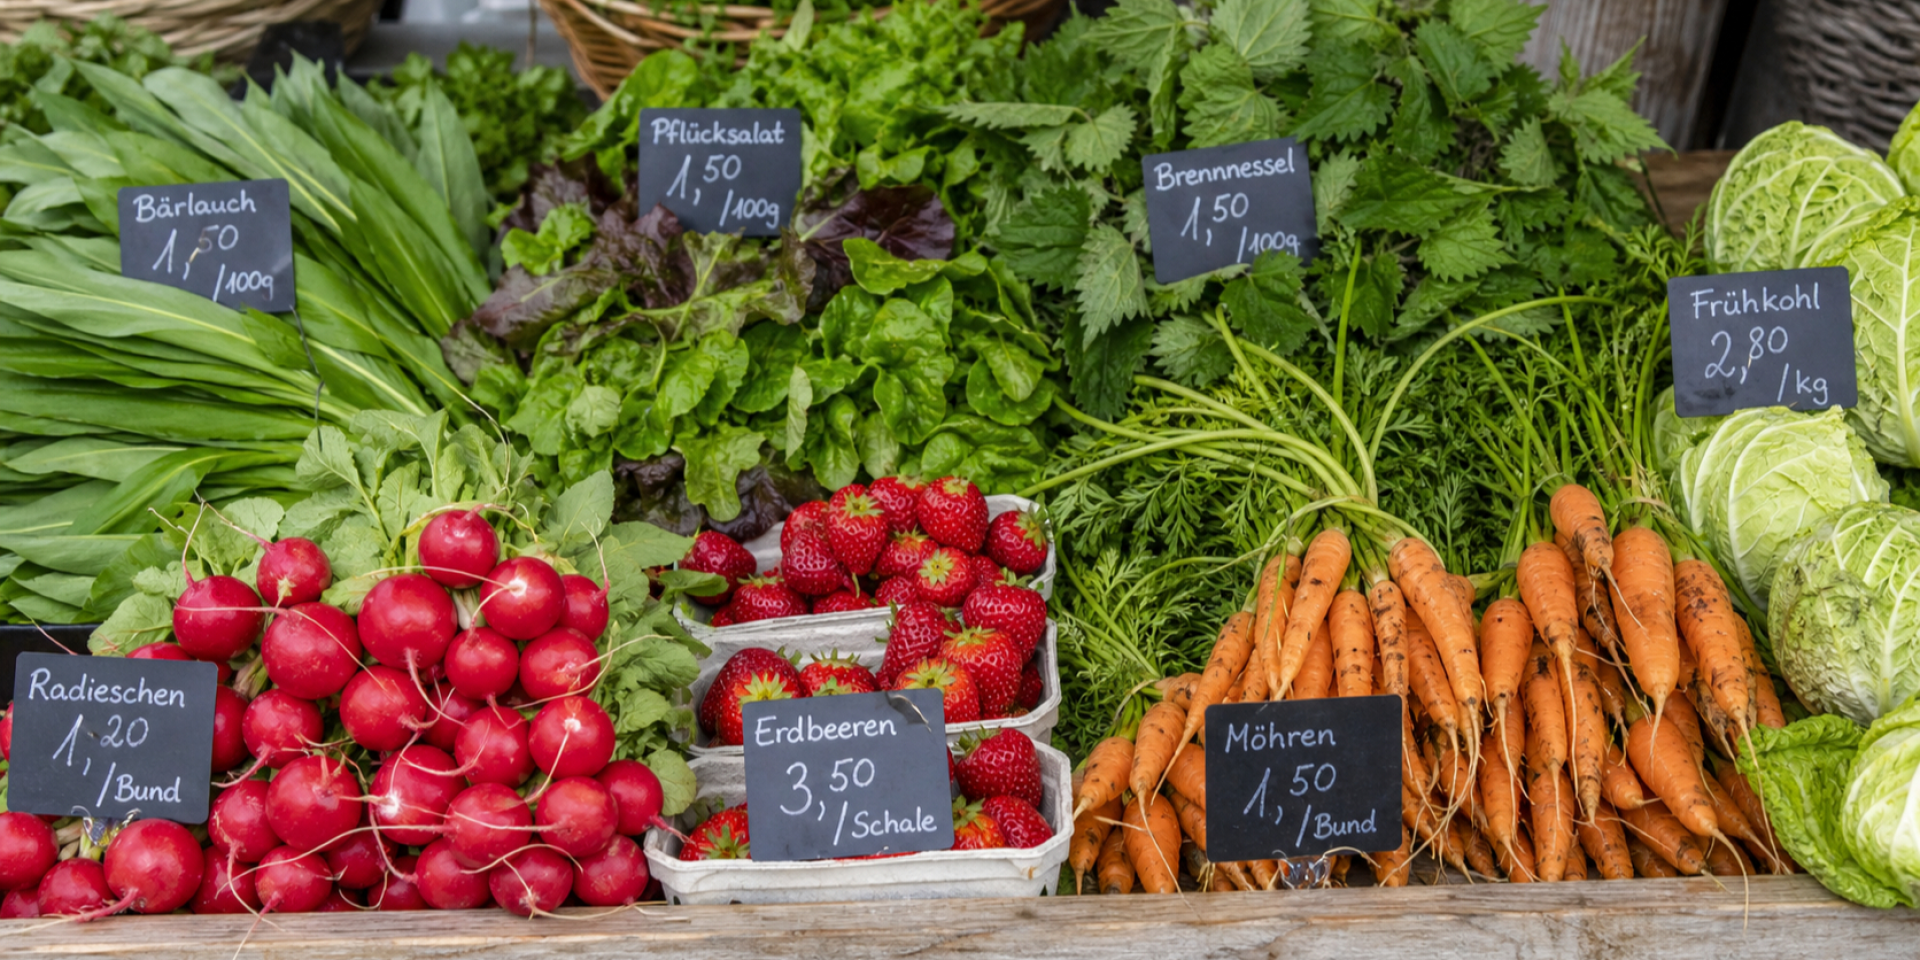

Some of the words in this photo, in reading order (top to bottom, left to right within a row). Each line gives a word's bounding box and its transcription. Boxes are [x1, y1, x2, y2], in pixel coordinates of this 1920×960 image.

[650, 117, 785, 145] Pflücksalat
[666, 154, 742, 206] 1,50
[1153, 146, 1295, 191] Brennnessel
[132, 189, 257, 223] Bärlauch
[719, 189, 780, 229] /100g
[1180, 192, 1249, 247] 1,50
[152, 224, 239, 281] 1,50
[1236, 226, 1301, 263] /100g
[212, 263, 274, 303] /100g
[1690, 281, 1820, 319] Frühkohl
[1704, 326, 1789, 385] 2,80
[1777, 363, 1829, 406] /kg
[28, 667, 186, 708] Radieschen
[52, 714, 149, 776] 1,20
[754, 714, 897, 747] Erdbeeren
[1224, 721, 1337, 754] Möhren
[95, 761, 182, 808] /Bund
[779, 758, 876, 821] 3,50
[1243, 762, 1337, 825] 1,50
[833, 800, 938, 846] /Schale
[1295, 803, 1378, 848] /Bund
